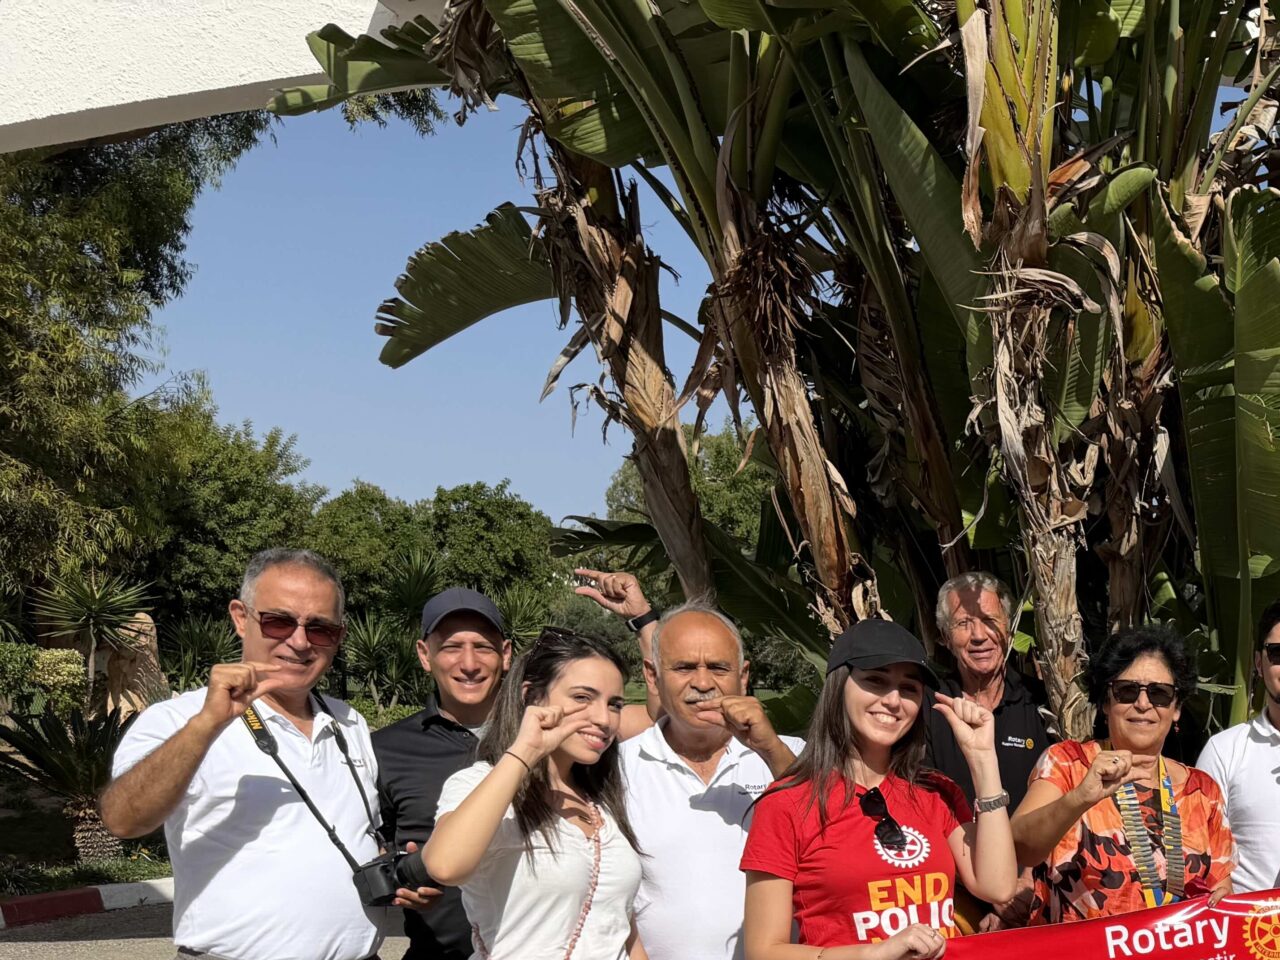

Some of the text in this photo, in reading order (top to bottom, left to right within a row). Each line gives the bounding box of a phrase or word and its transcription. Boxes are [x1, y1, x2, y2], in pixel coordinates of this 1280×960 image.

[245, 705, 263, 730] Niko
[868, 872, 949, 912] END
[1105, 916, 1230, 959] Rotary
